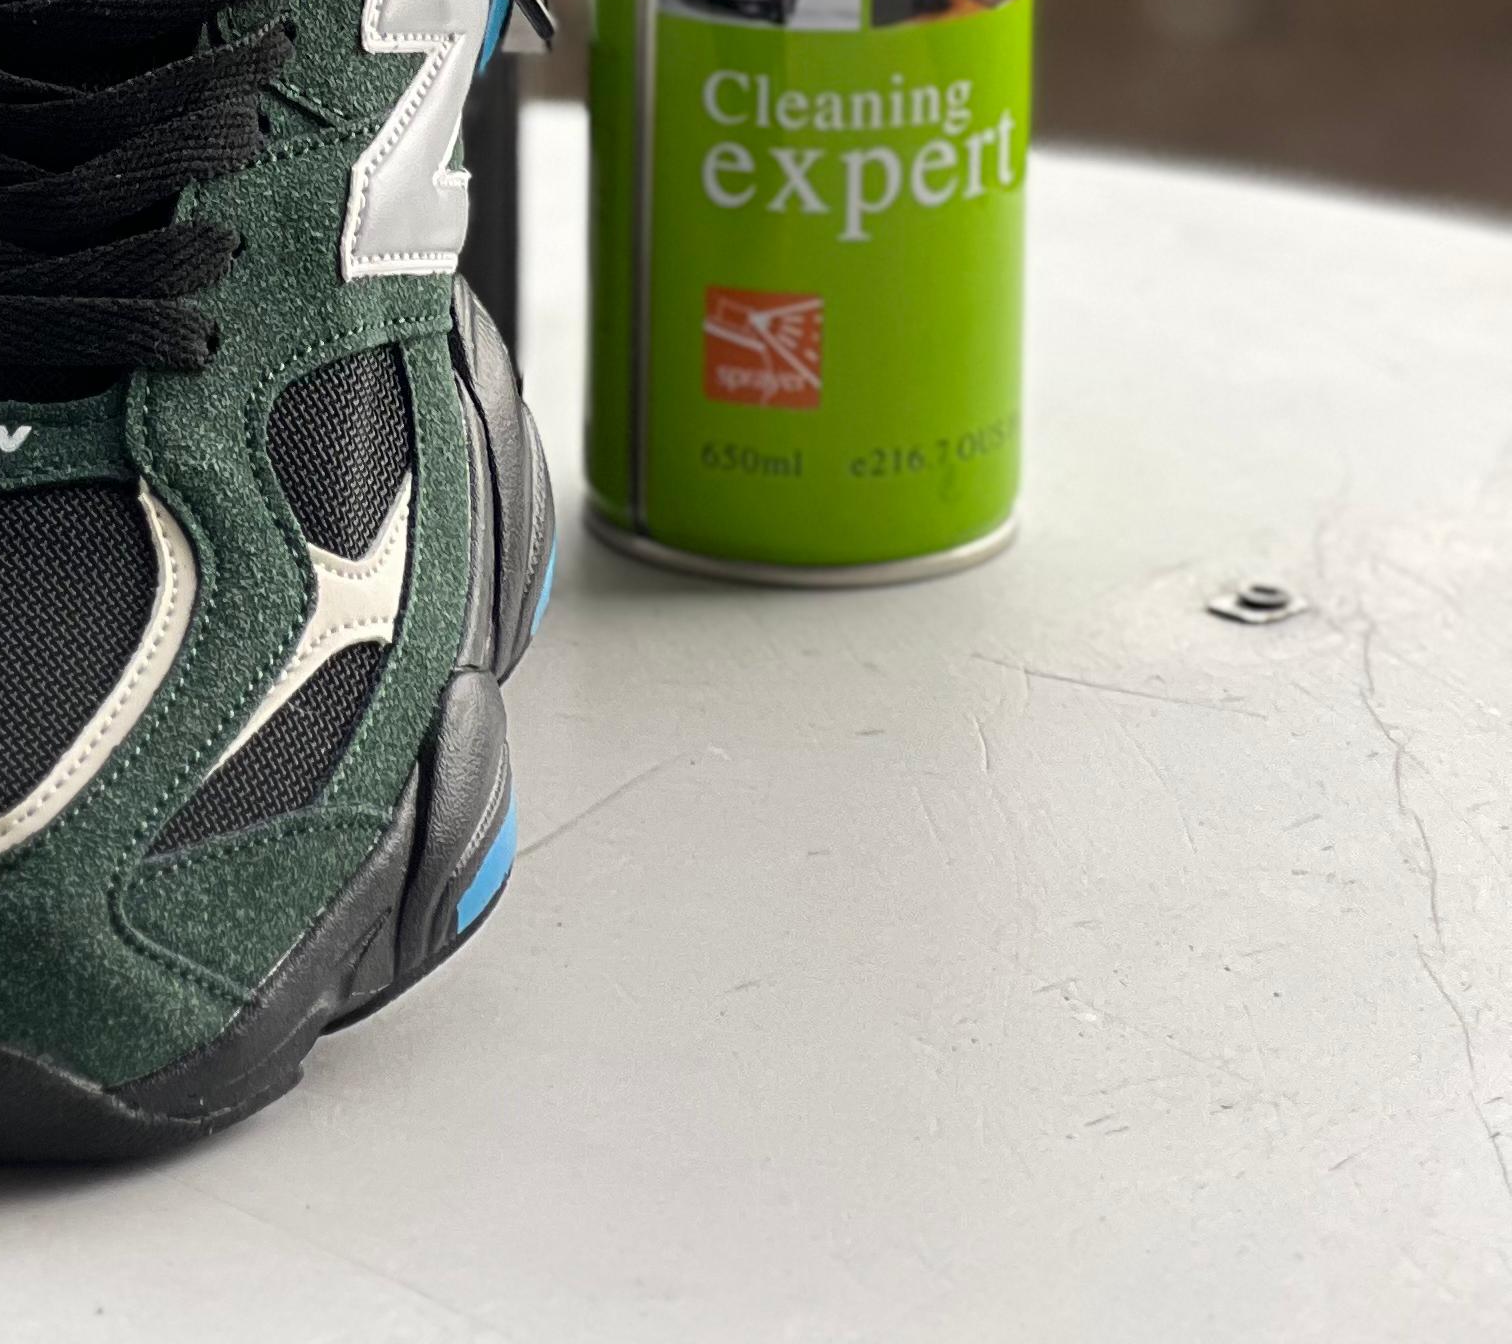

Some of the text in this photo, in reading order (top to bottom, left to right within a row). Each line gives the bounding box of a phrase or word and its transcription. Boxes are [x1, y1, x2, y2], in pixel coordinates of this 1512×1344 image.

[702, 69, 974, 136] Cleaning
[701, 109, 1016, 242] expert
[701, 442, 804, 478] 650ml
